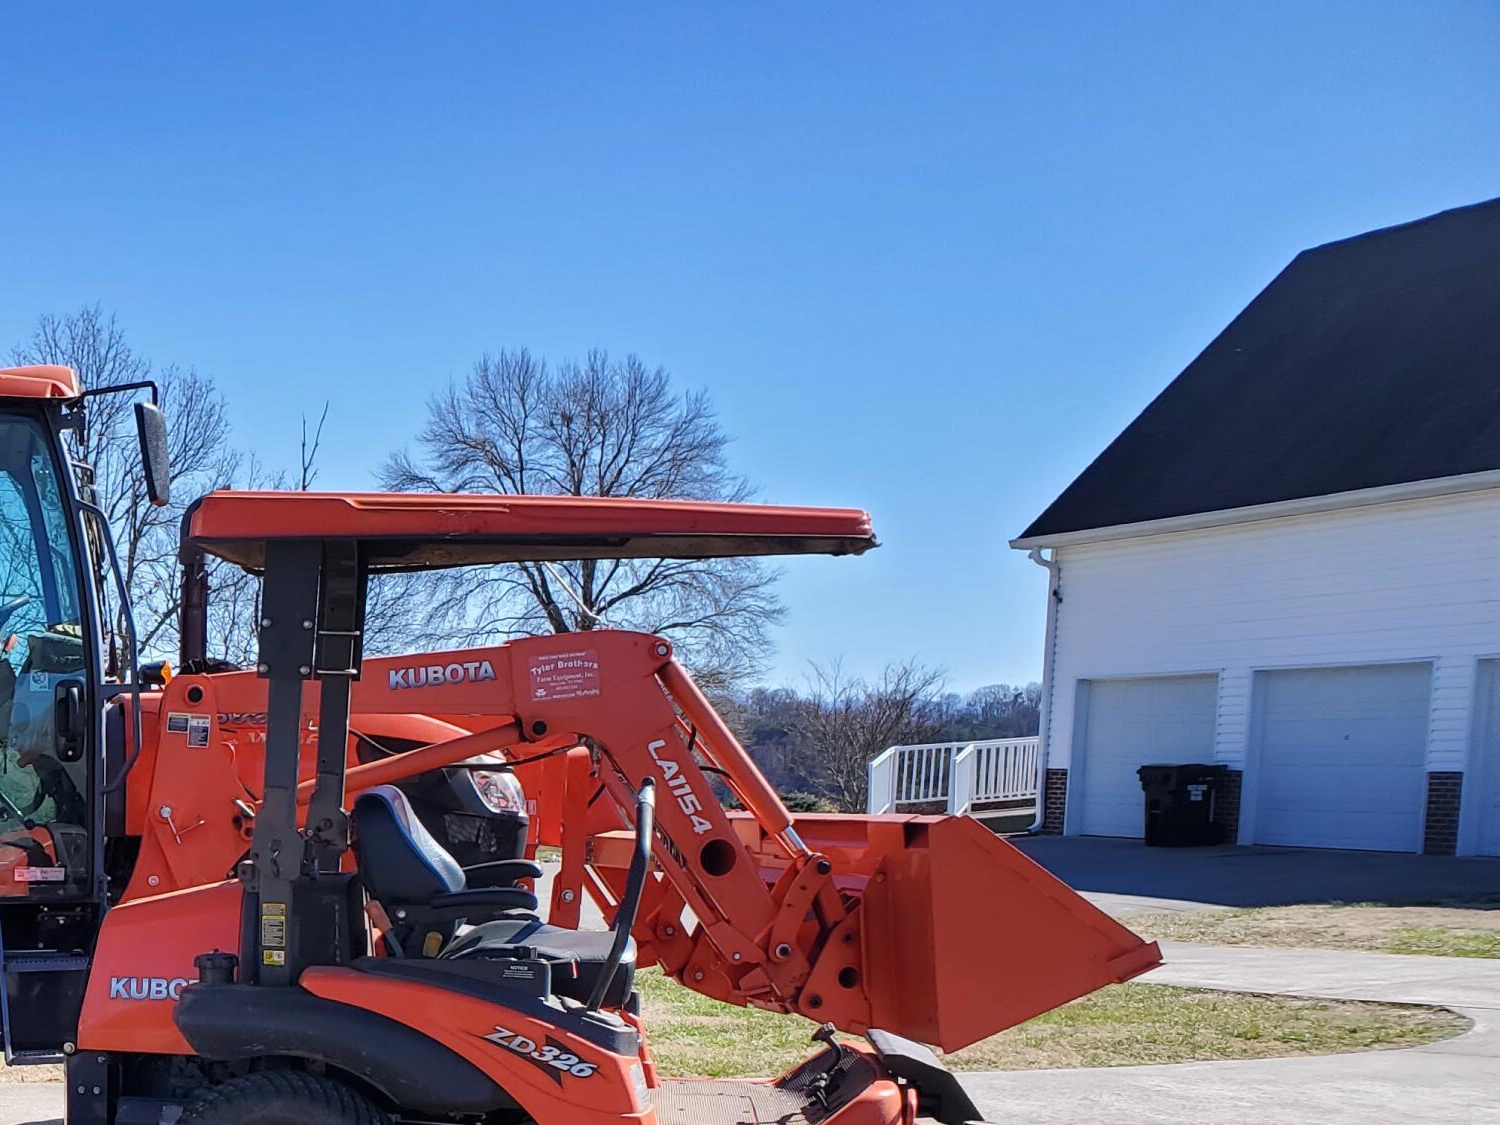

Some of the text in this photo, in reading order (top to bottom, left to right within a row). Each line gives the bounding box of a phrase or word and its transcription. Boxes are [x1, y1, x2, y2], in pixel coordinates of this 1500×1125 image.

[389, 661, 497, 690] KUBOTA
[530, 659, 598, 675] Tyler Brothers
[647, 739, 713, 835] LA1154
[110, 977, 199, 1000] KUBO
[483, 1026, 599, 1078] ZD326
